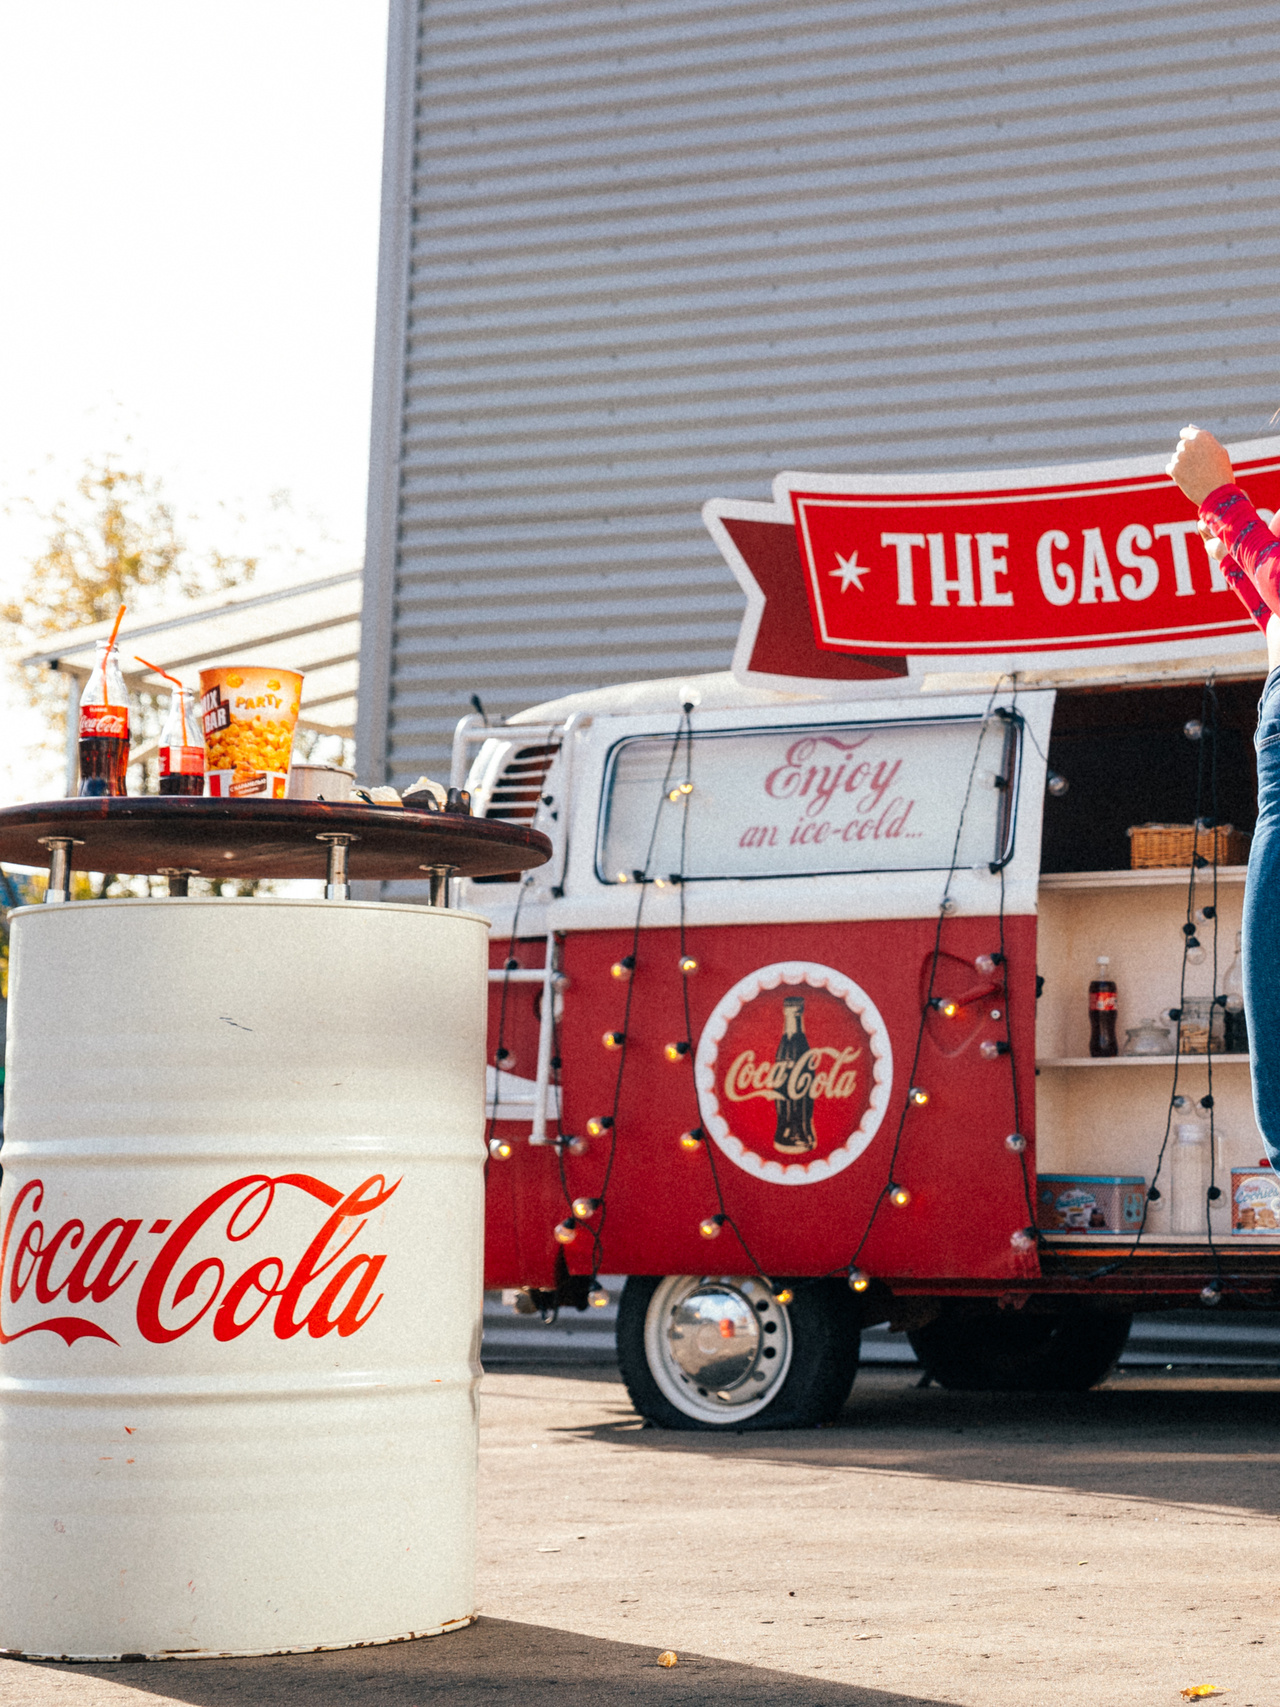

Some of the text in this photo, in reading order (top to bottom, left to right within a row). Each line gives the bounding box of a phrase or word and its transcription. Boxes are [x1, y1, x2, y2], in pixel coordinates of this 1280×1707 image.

[880, 531, 1015, 607] THE
[204, 707, 227, 733] BAR
[235, 693, 283, 710] PARTY
[764, 733, 903, 819] Enjoy
[739, 796, 923, 849] an ice-cold...
[724, 1046, 862, 1102] Coca-Cola
[0, 1174, 404, 1347] Coca-Cola
